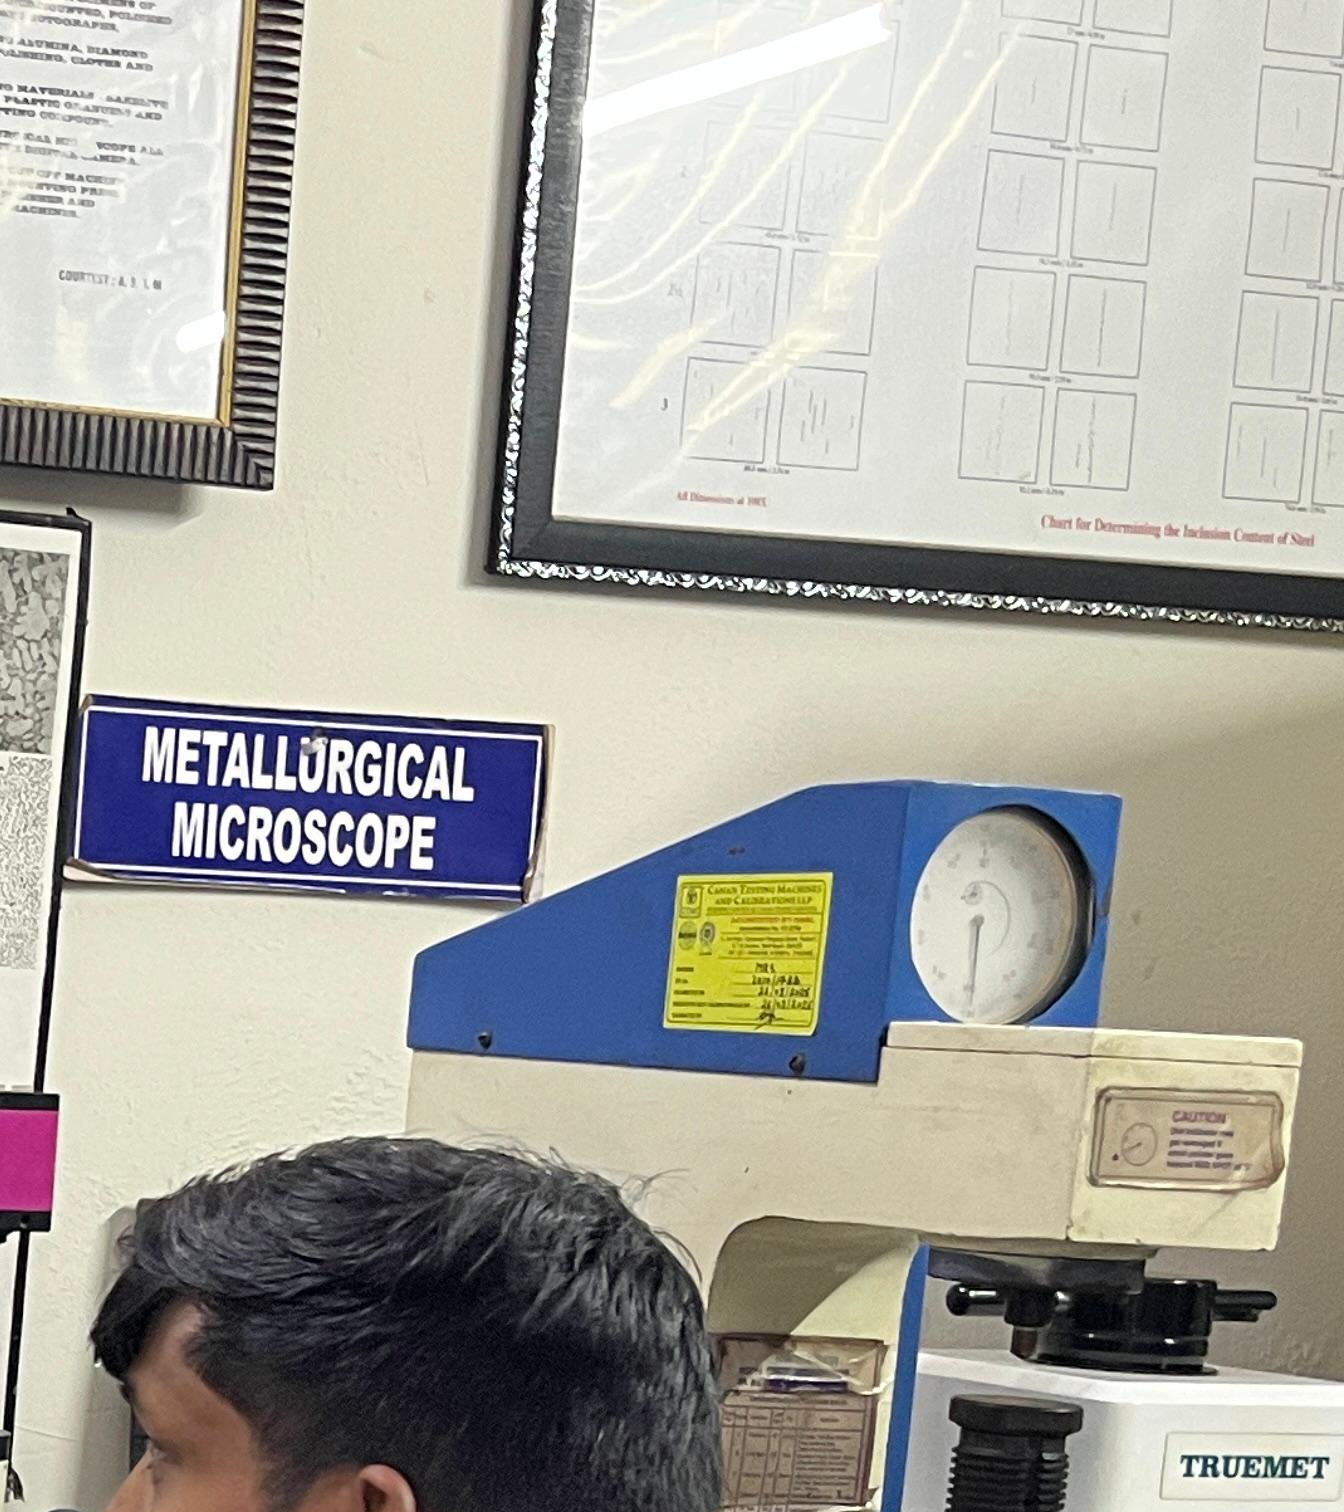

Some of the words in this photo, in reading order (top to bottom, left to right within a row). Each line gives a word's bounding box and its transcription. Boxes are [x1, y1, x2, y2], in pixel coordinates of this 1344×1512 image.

[1041, 514, 1073, 531] Chart
[1075, 517, 1091, 531] for
[1094, 518, 1162, 539] Determining
[1163, 522, 1180, 537] the
[1234, 528, 1275, 544] Content
[1277, 532, 1288, 545] of
[141, 725, 475, 803] METALLURGICAL
[171, 800, 437, 871] MICROSCOPE
[1180, 1452, 1330, 1481] TRUEMET
